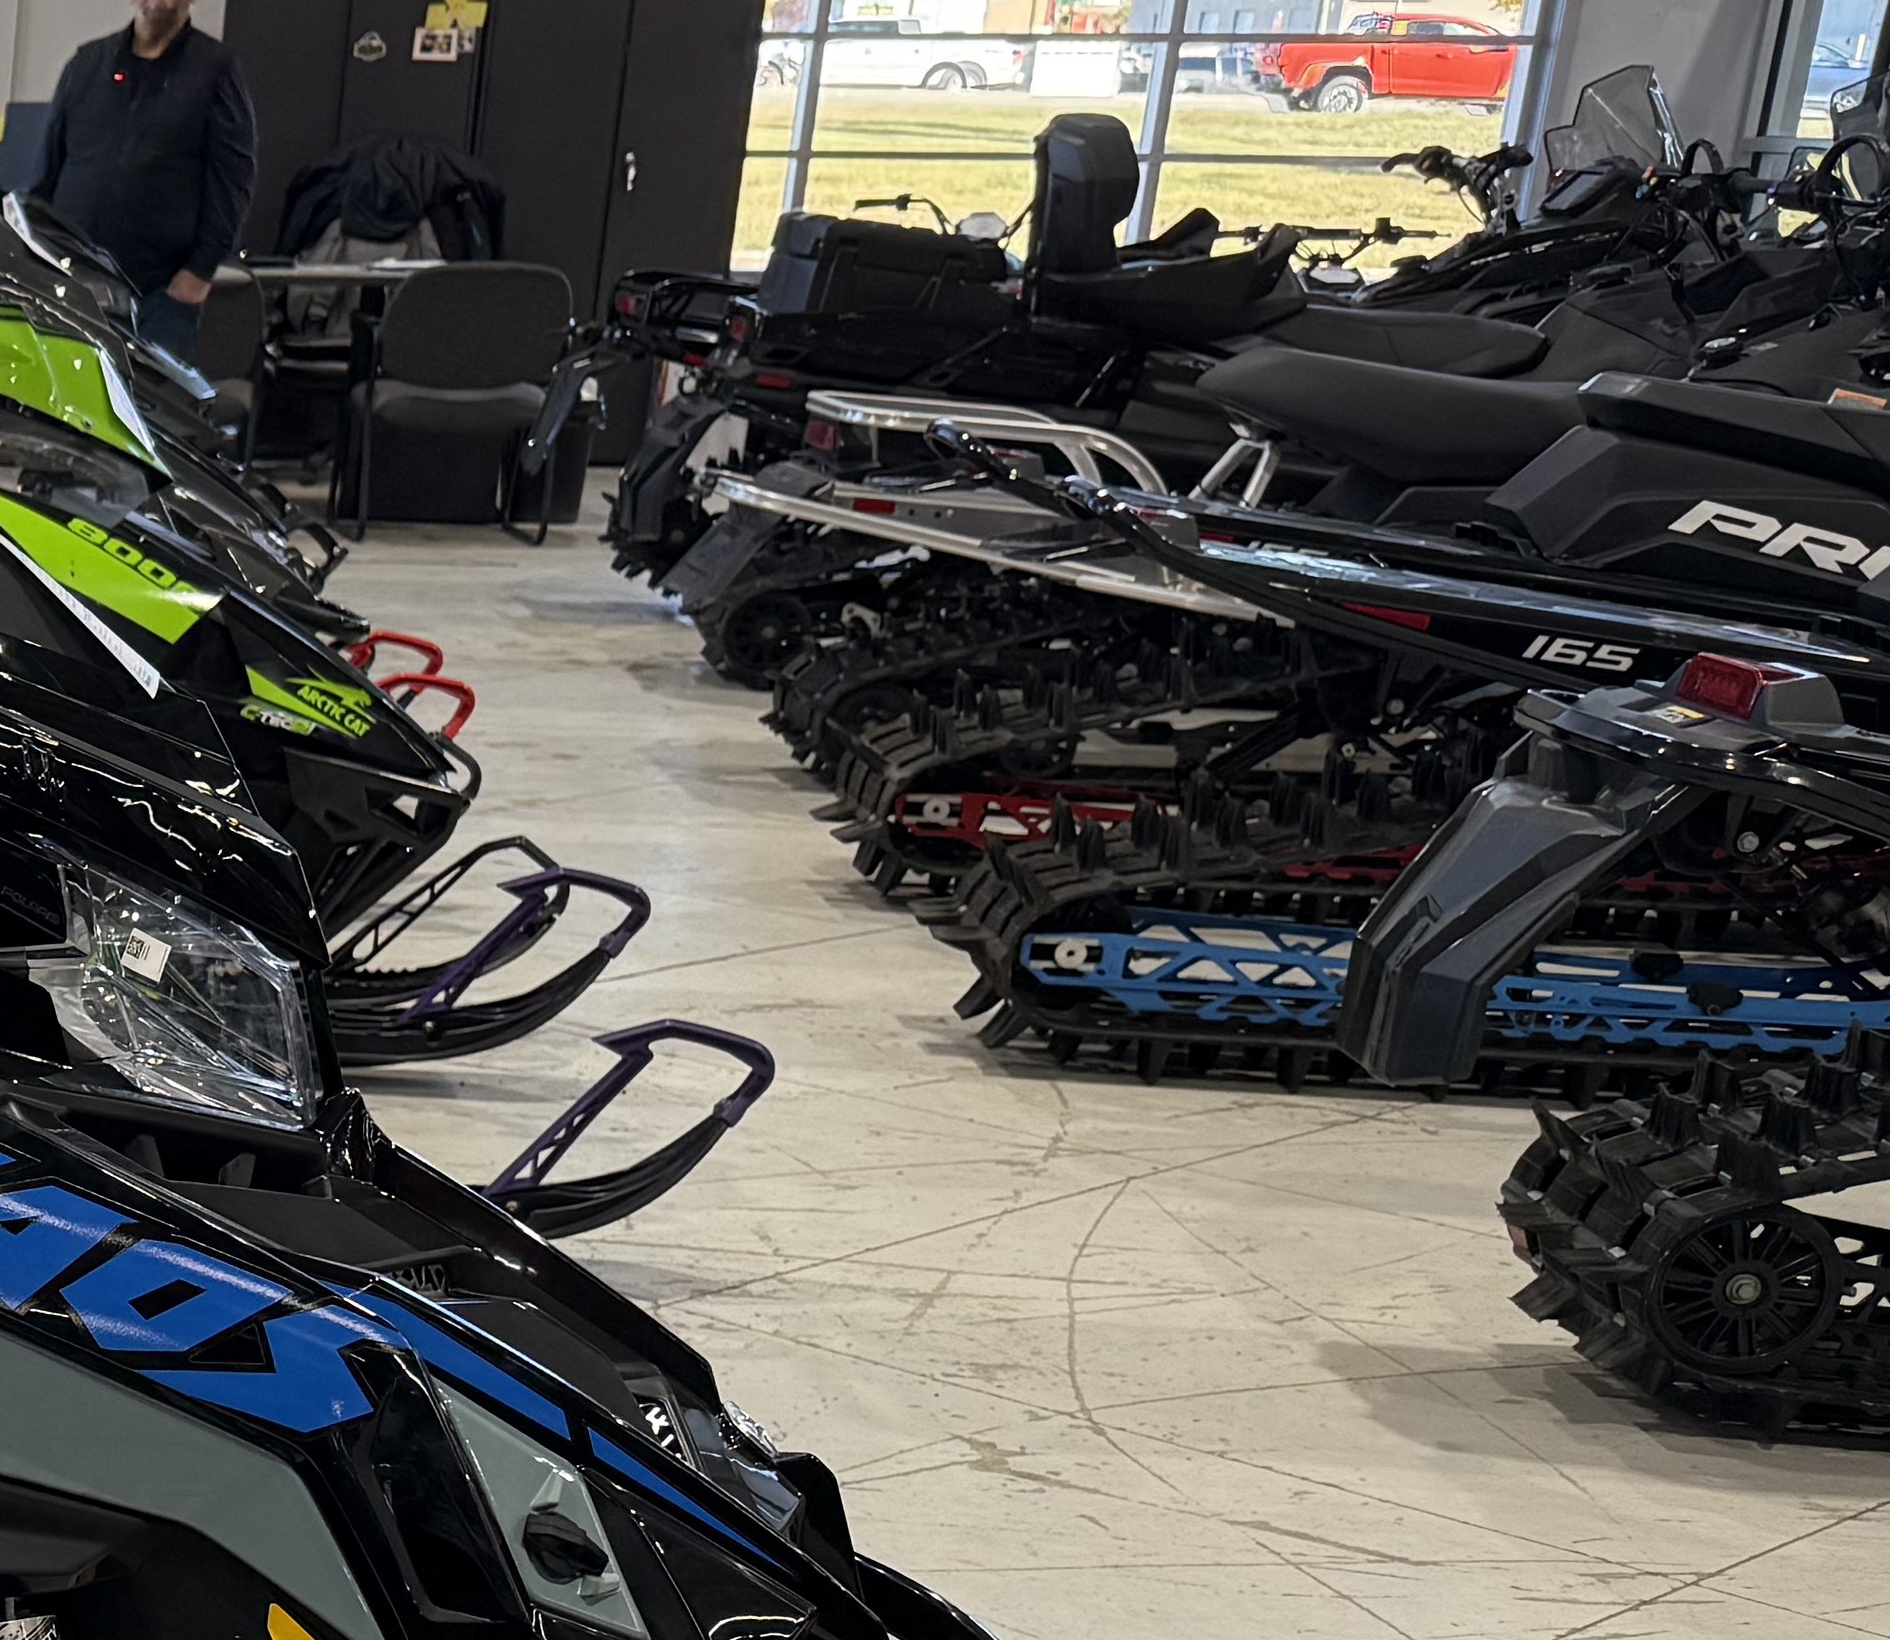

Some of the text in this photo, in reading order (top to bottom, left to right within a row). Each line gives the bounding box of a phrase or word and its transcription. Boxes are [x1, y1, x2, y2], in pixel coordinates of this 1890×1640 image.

[1522, 634, 1640, 672] 165
[297, 685, 371, 737] ARCTIC CAT
